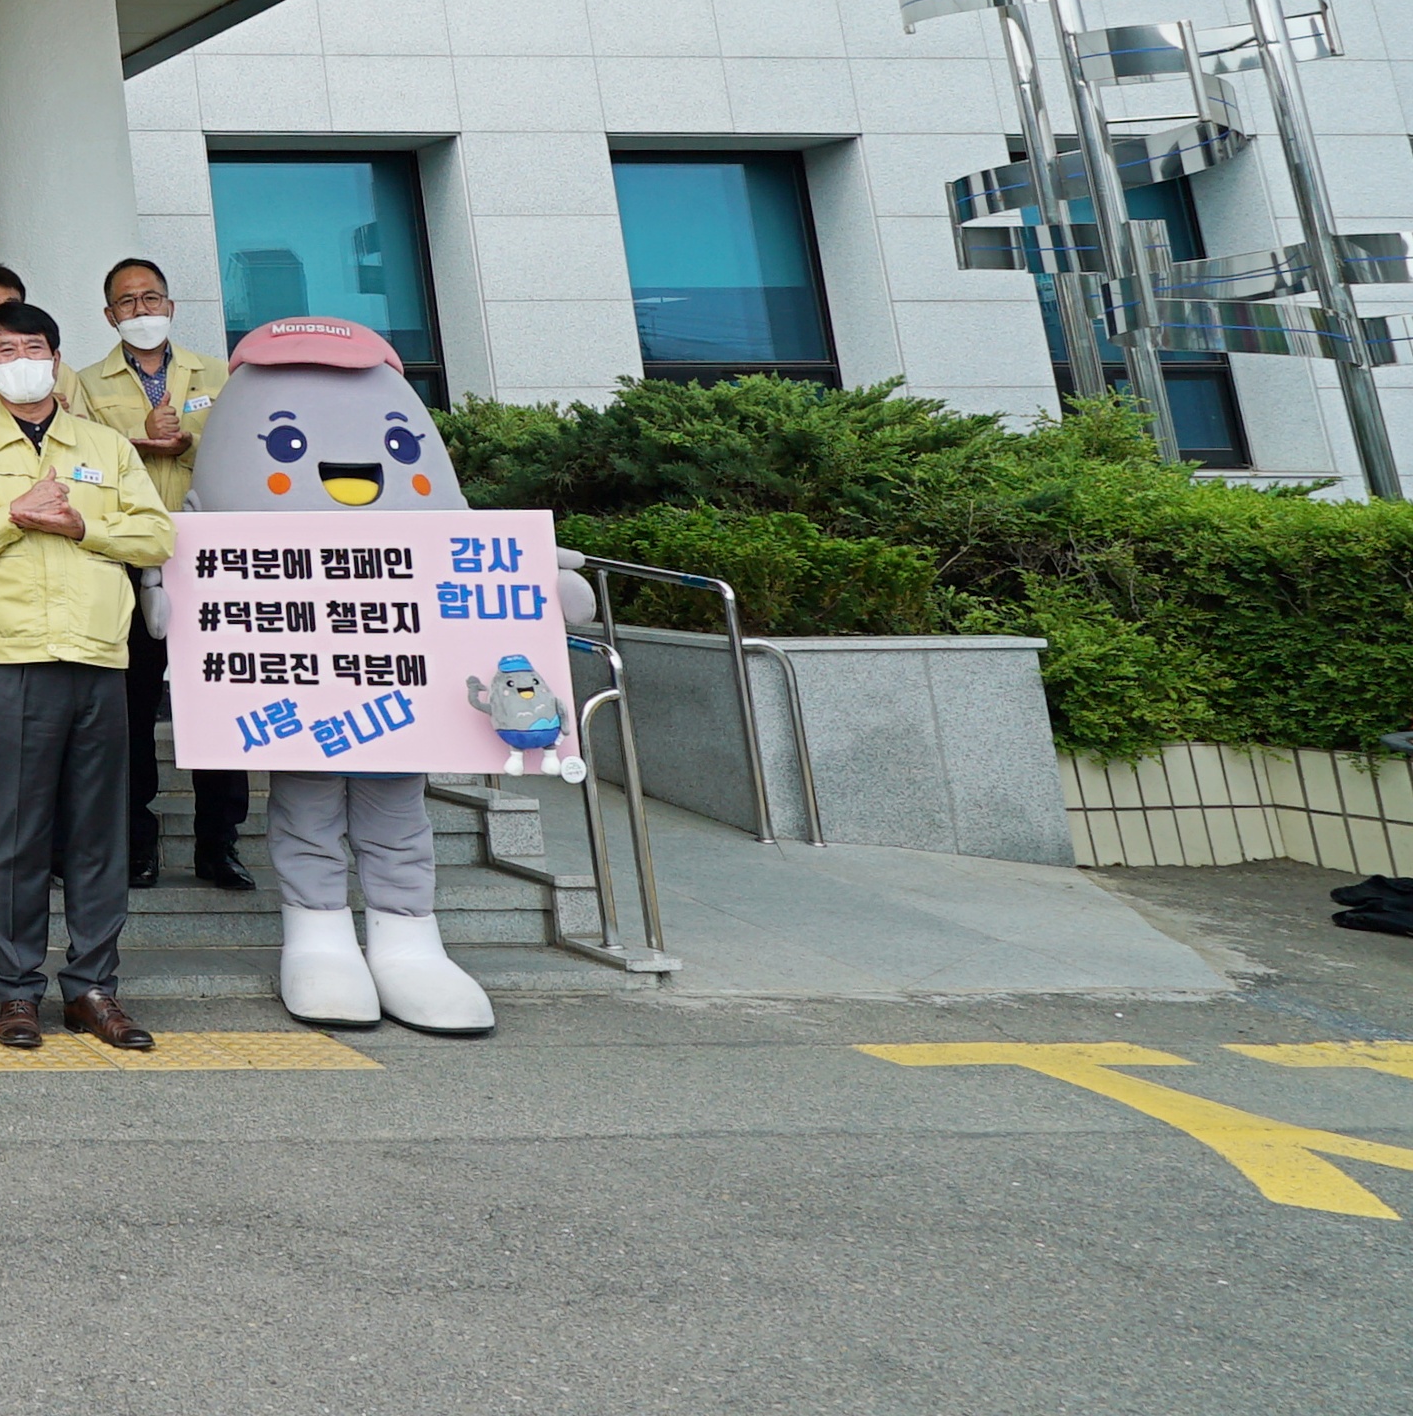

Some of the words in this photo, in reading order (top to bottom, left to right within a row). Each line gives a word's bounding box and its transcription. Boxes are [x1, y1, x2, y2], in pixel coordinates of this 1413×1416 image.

[272, 323, 351, 337] Mongsuni
[195, 547, 312, 580] #덕분에
[320, 547, 414, 580] 캠페인
[449, 537, 523, 574] 감사
[198, 601, 317, 633] #덕분에
[326, 600, 421, 634] 챌린지
[435, 581, 548, 621] 합니다
[202, 652, 320, 685] #의료진
[332, 654, 427, 687] 덕분에
[235, 697, 304, 752] 사랑
[308, 689, 416, 758] 합니다
